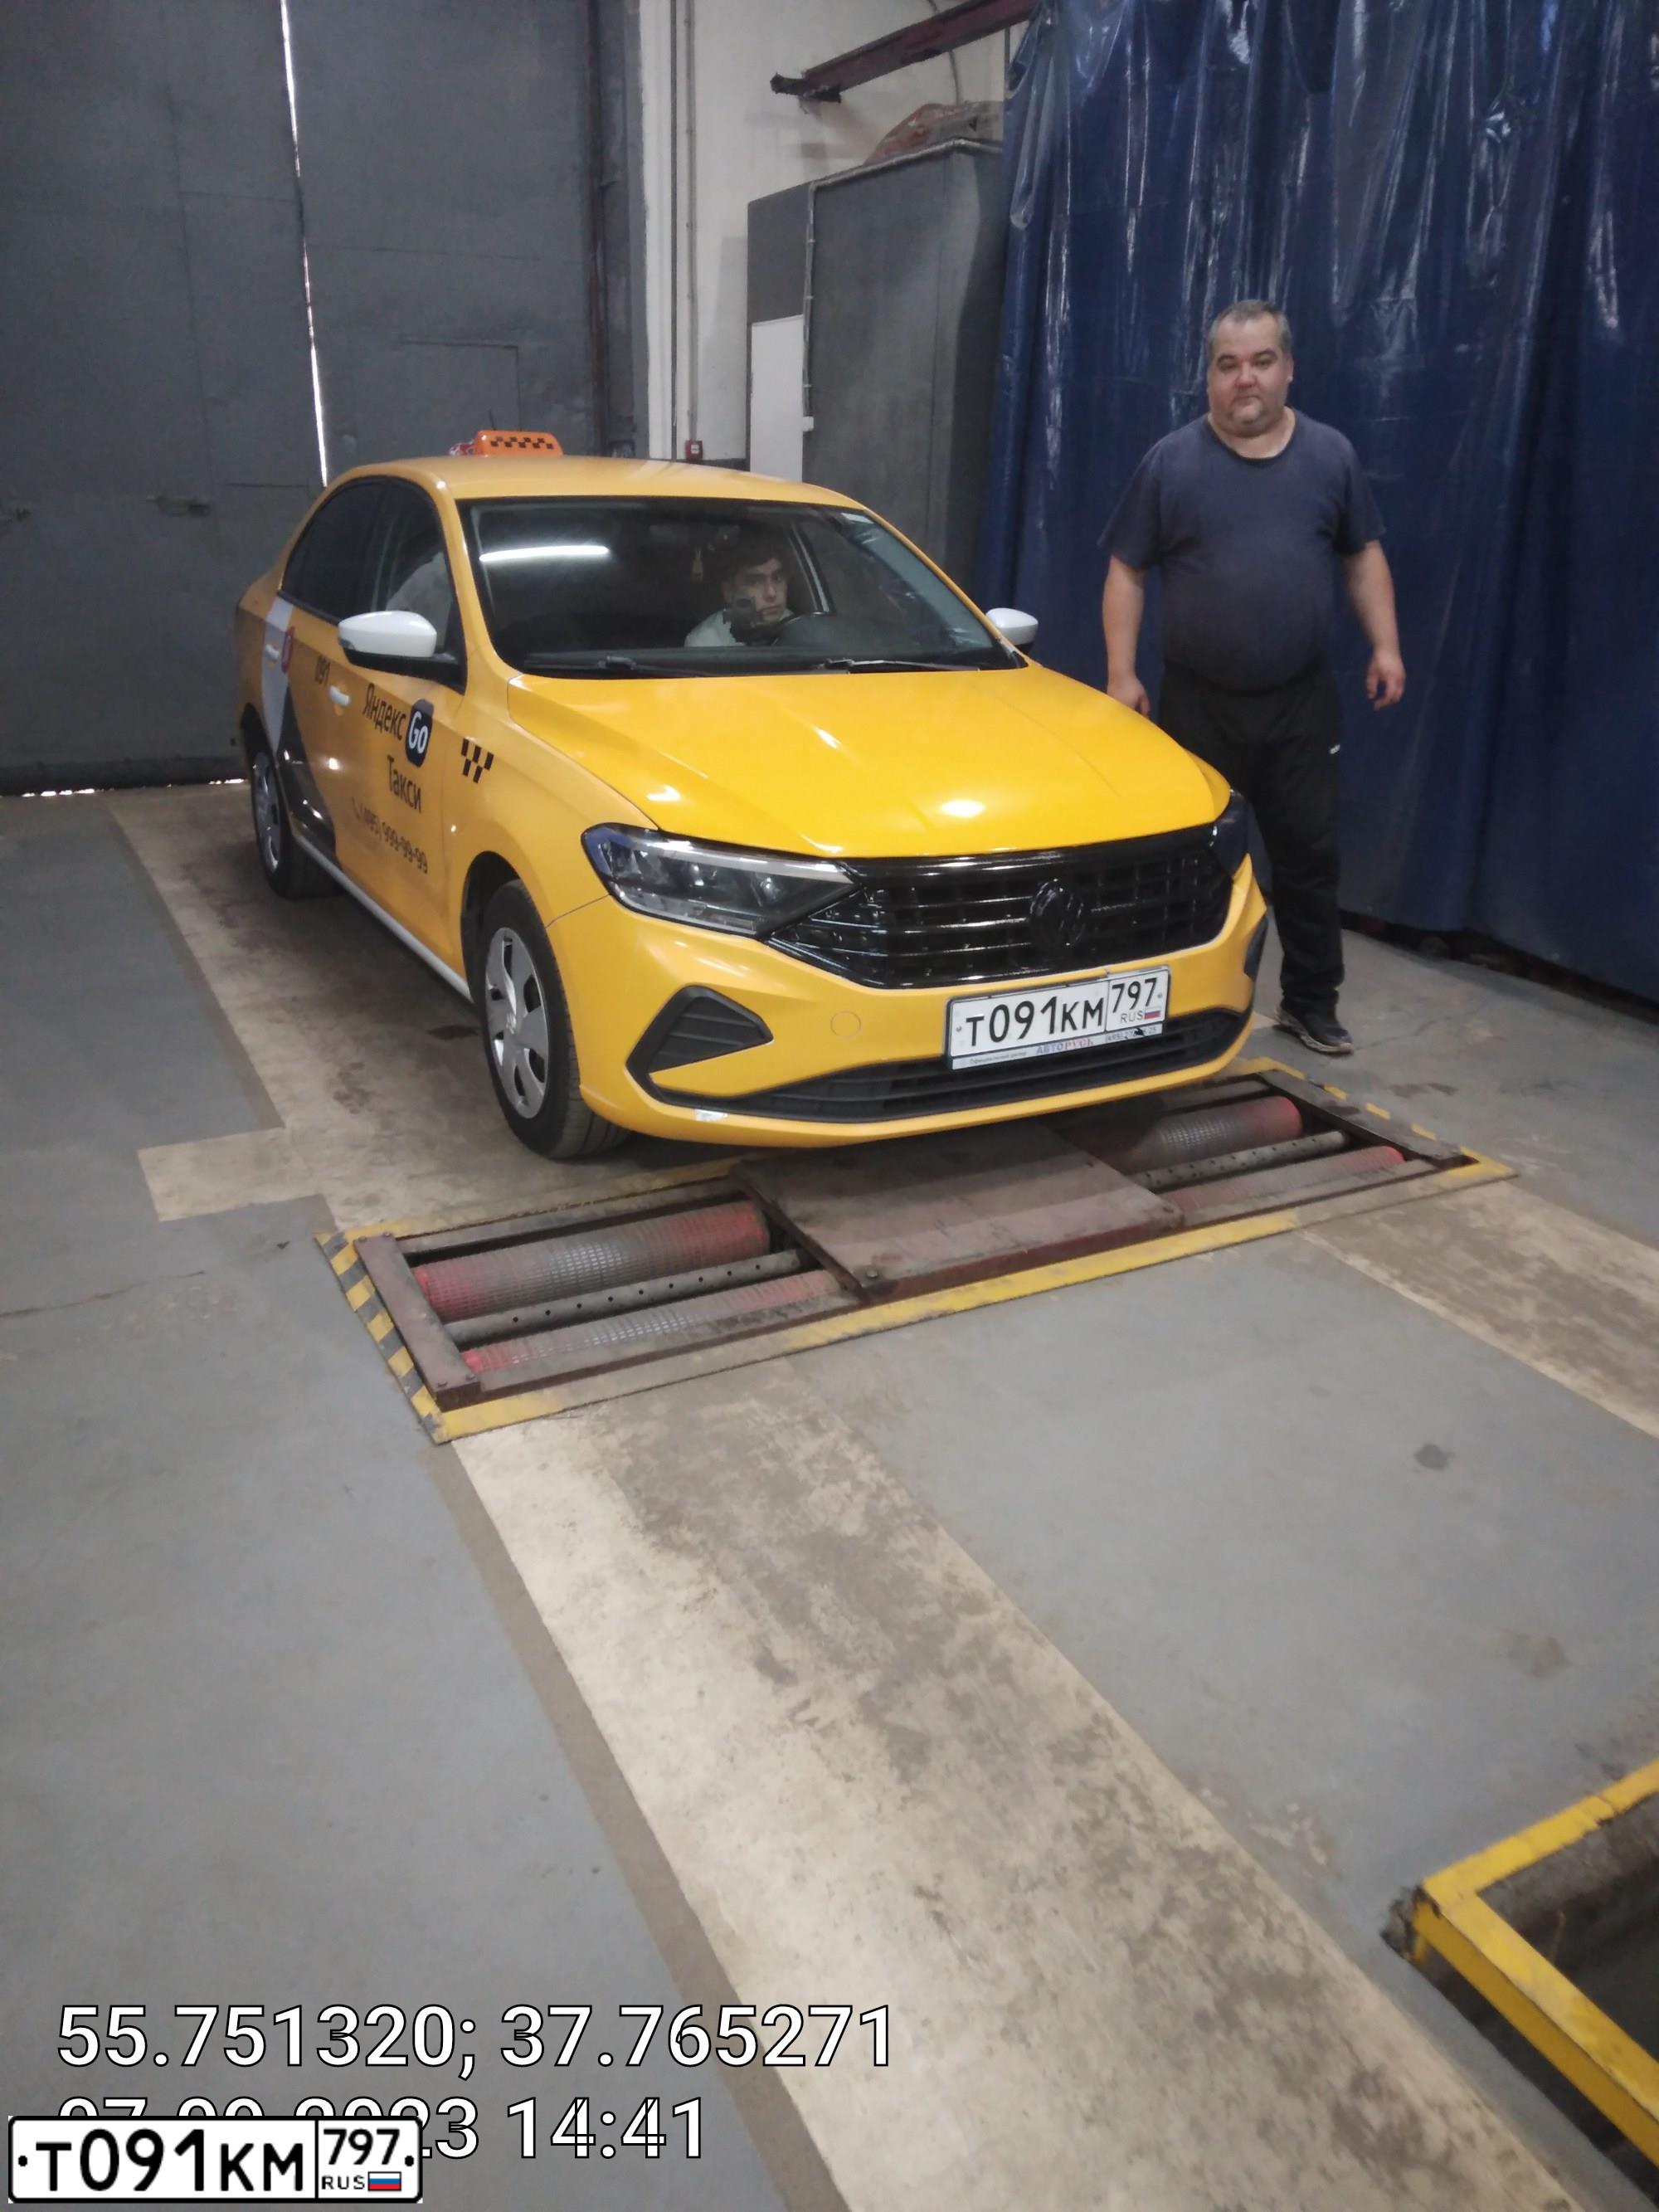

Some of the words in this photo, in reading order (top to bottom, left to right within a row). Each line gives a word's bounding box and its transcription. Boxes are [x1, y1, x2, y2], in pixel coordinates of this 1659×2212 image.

[362, 683, 406, 741] Яндекс
[408, 711, 428, 753] Go
[387, 754, 421, 813] Такси
[966, 996, 1104, 1046] Т091КМ
[1112, 977, 1157, 1014] 797
[1120, 1010, 1144, 1024] RUS
[1037, 1039, 1095, 1054] АВТОРУСЬ
